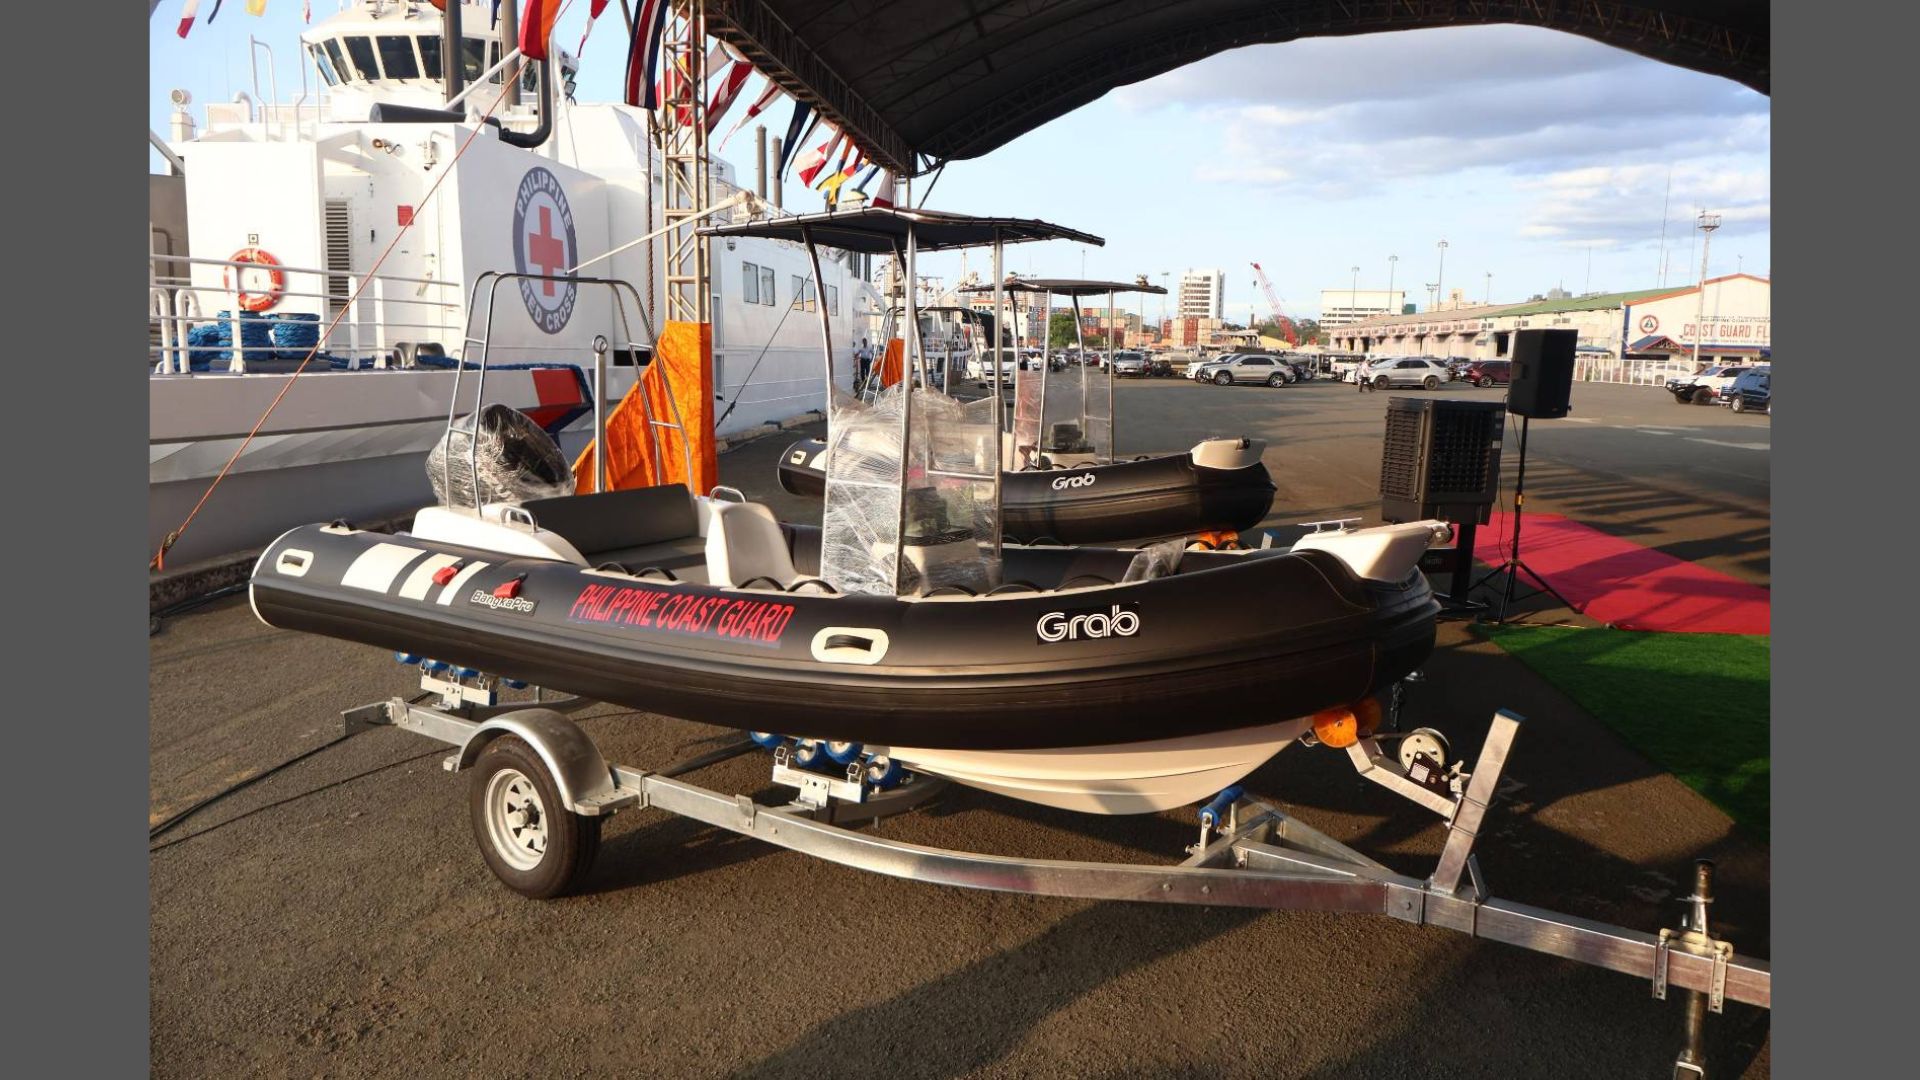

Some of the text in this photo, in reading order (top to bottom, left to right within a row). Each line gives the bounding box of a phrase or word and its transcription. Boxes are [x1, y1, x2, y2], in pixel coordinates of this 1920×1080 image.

[517, 172, 572, 231] PHILIPPINE
[521, 279, 575, 330] RED CROSS
[1719, 324, 1751, 338] GUARD
[1052, 472, 1096, 490] Grab
[470, 590, 534, 612] BangkaPro
[569, 583, 796, 642] PHILIPPINE COAST GUARD
[1036, 604, 1140, 642] Grab
